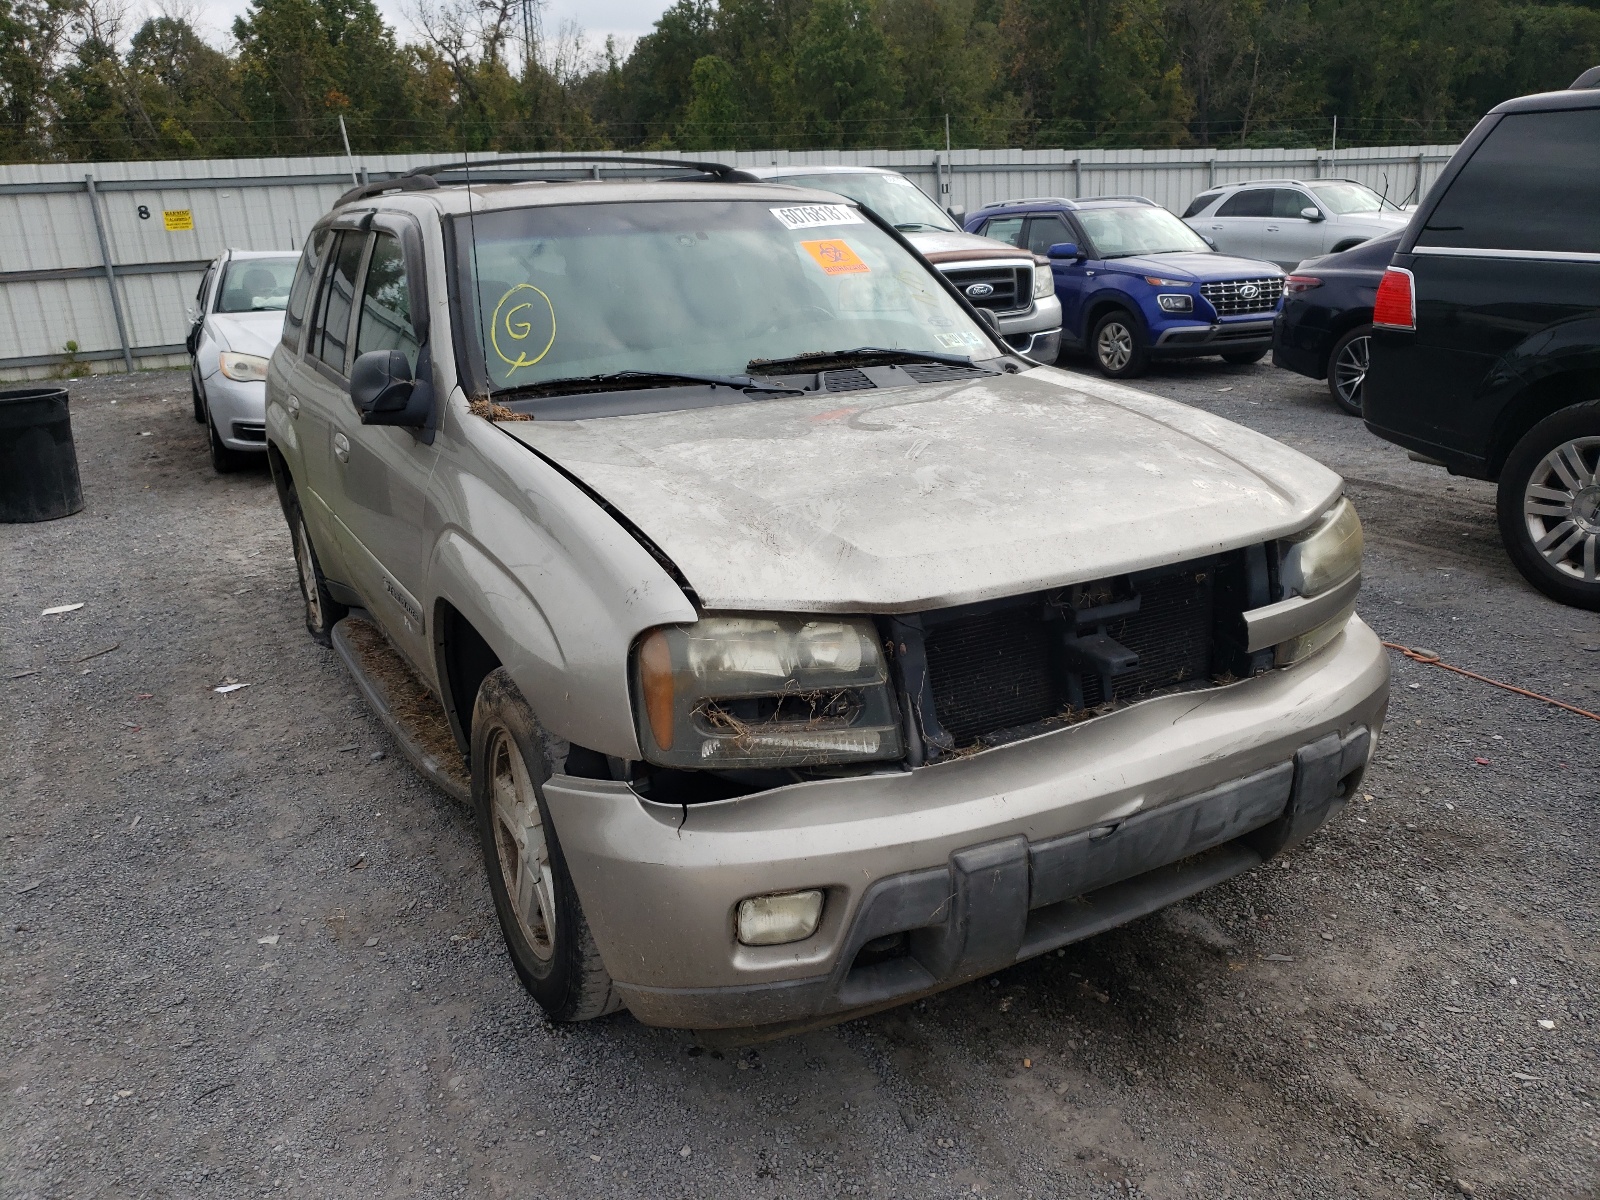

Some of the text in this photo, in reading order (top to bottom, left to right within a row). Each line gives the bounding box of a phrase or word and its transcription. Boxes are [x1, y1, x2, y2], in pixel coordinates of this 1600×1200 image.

[138, 205, 150, 219] 8
[780, 206, 847, 224] 60768181
[824, 264, 868, 273] BIOHAZARD
[505, 303, 532, 339] G
